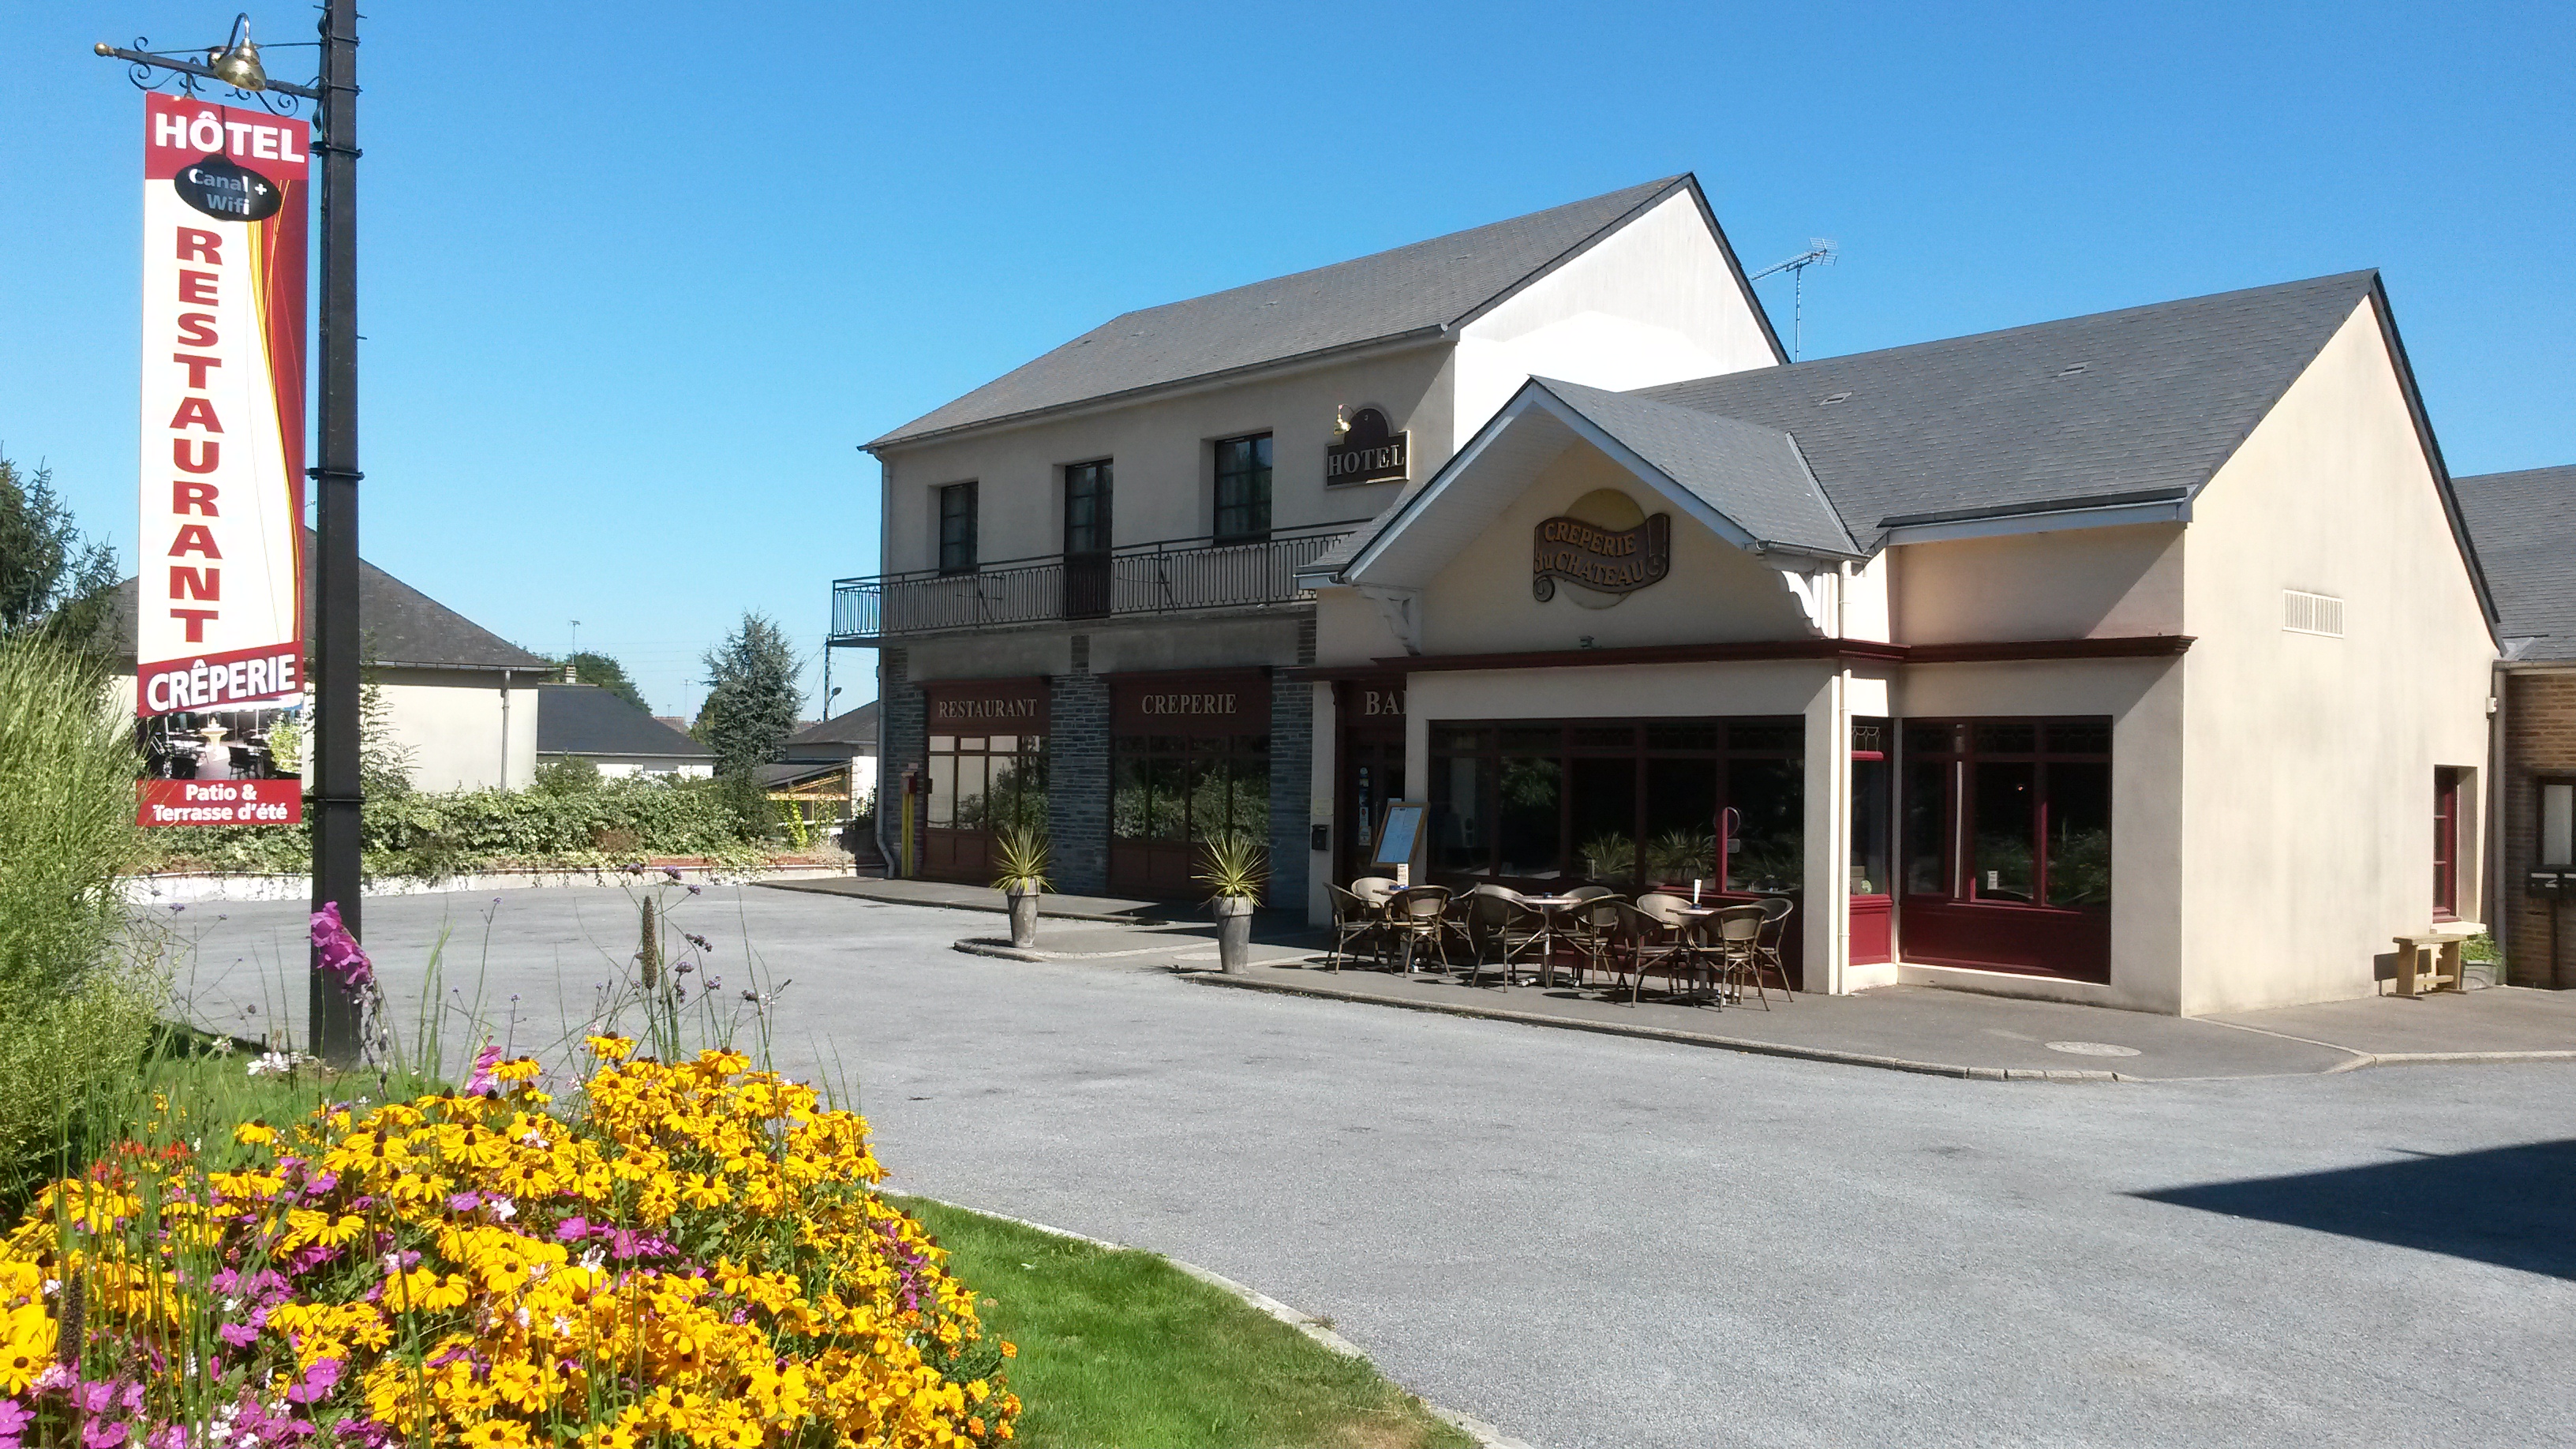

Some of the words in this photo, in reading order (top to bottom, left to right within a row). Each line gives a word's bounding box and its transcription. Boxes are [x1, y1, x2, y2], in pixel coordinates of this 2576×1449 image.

[155, 110, 305, 163] HÔTEL
[189, 168, 249, 193] Canal
[207, 192, 249, 215] Wifi
[167, 226, 224, 643] RESTAURANT
[1328, 444, 1405, 475] HOTEL
[1544, 522, 1637, 556] CREPERIE
[1554, 551, 1644, 586] CHATEAU
[147, 653, 296, 712] CRÊPERIE
[938, 698, 1039, 718] RESTAURANT
[1141, 694, 1237, 714] CREPERIE
[1365, 690, 1406, 716] BA
[185, 784, 237, 800] Patio
[242, 784, 256, 800] &
[152, 804, 233, 821] Terrasse
[238, 803, 288, 820] d'été
